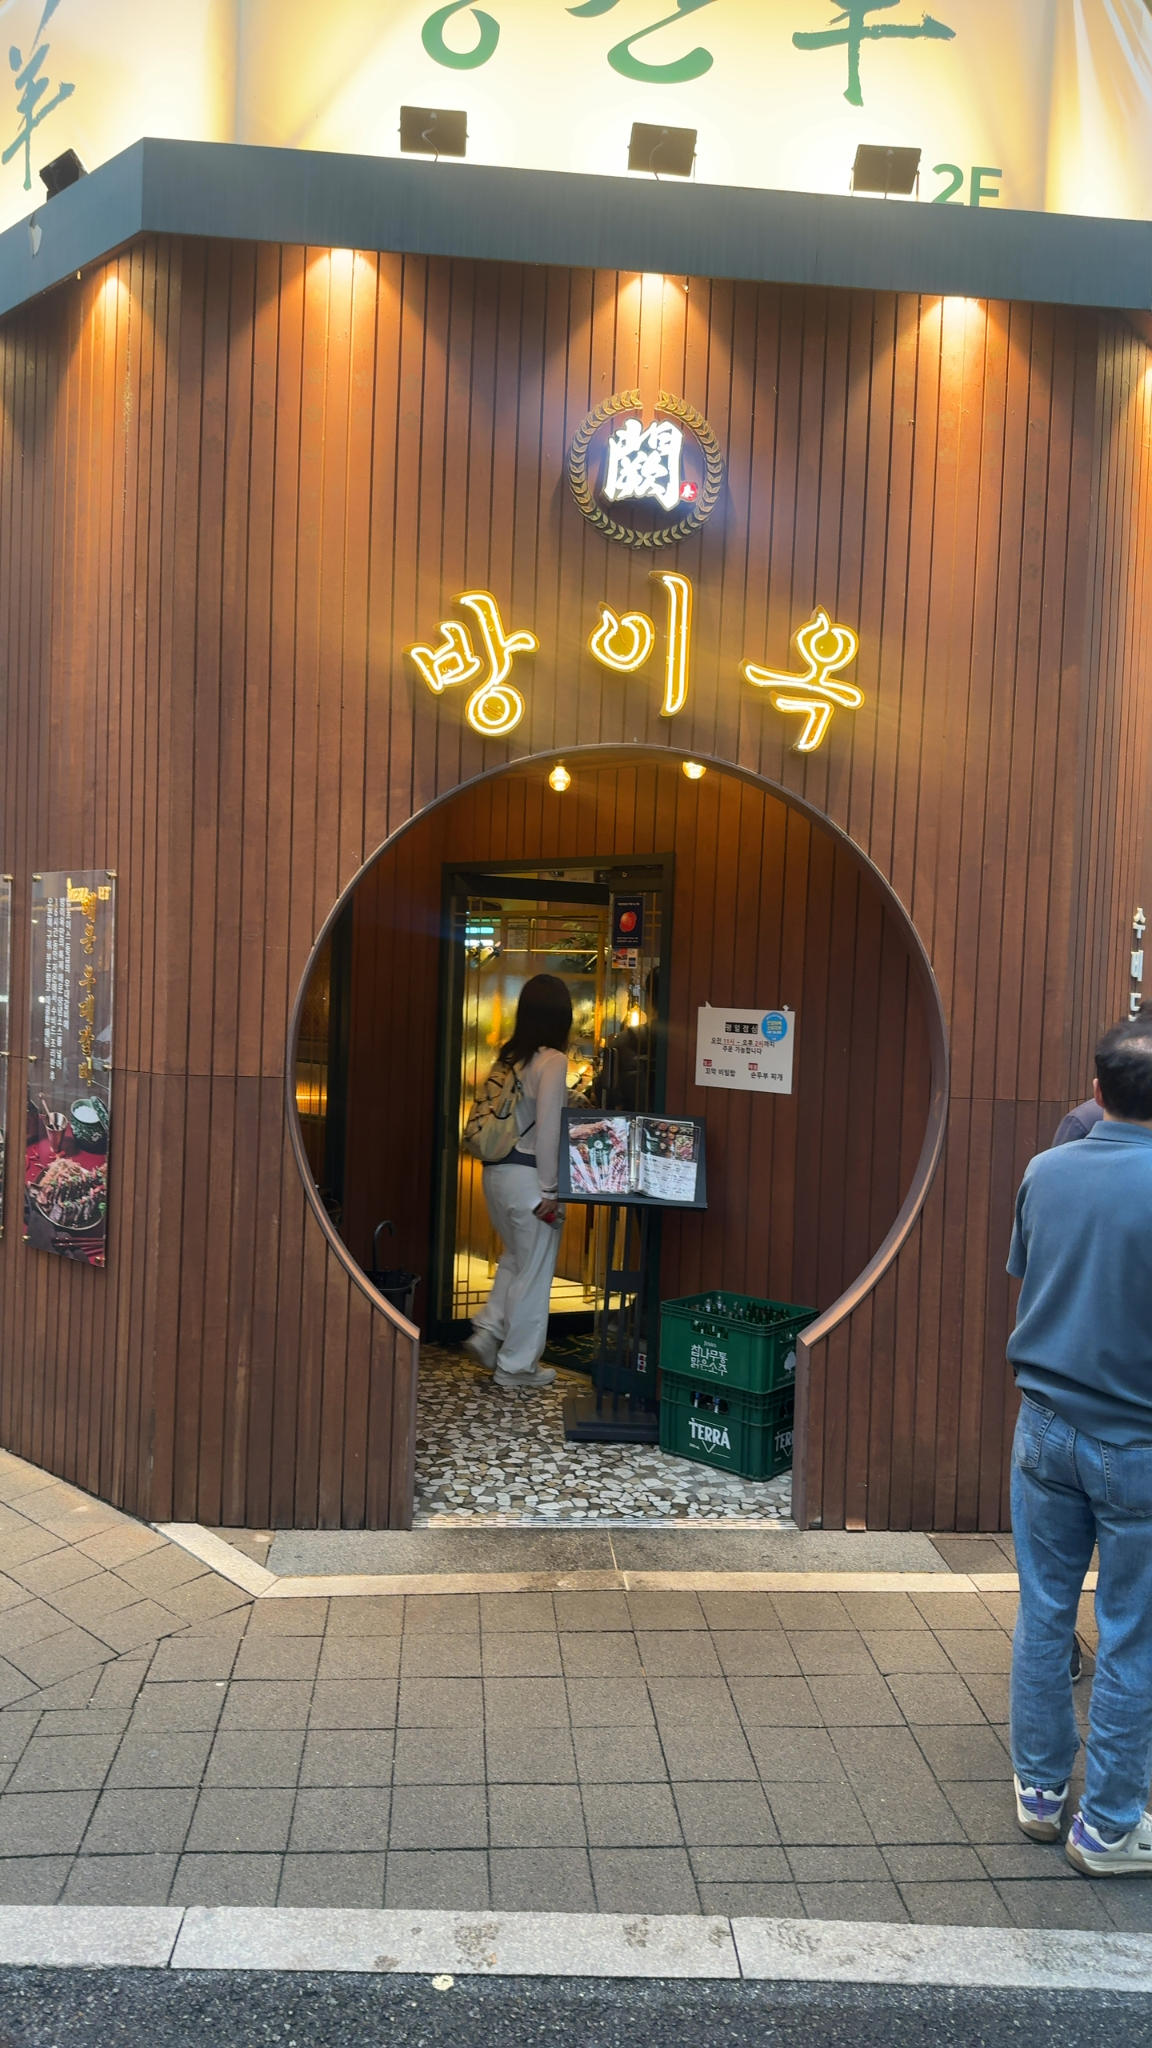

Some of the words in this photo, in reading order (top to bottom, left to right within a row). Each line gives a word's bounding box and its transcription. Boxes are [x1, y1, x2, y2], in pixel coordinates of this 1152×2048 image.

[932, 163, 1003, 207] 2F
[402, 571, 865, 754] 방이옥
[690, 1344, 728, 1364] 참나무통
[690, 1357, 728, 1376] 맑은소주
[688, 1420, 731, 1450] TERRA
[774, 1431, 794, 1452] TER
